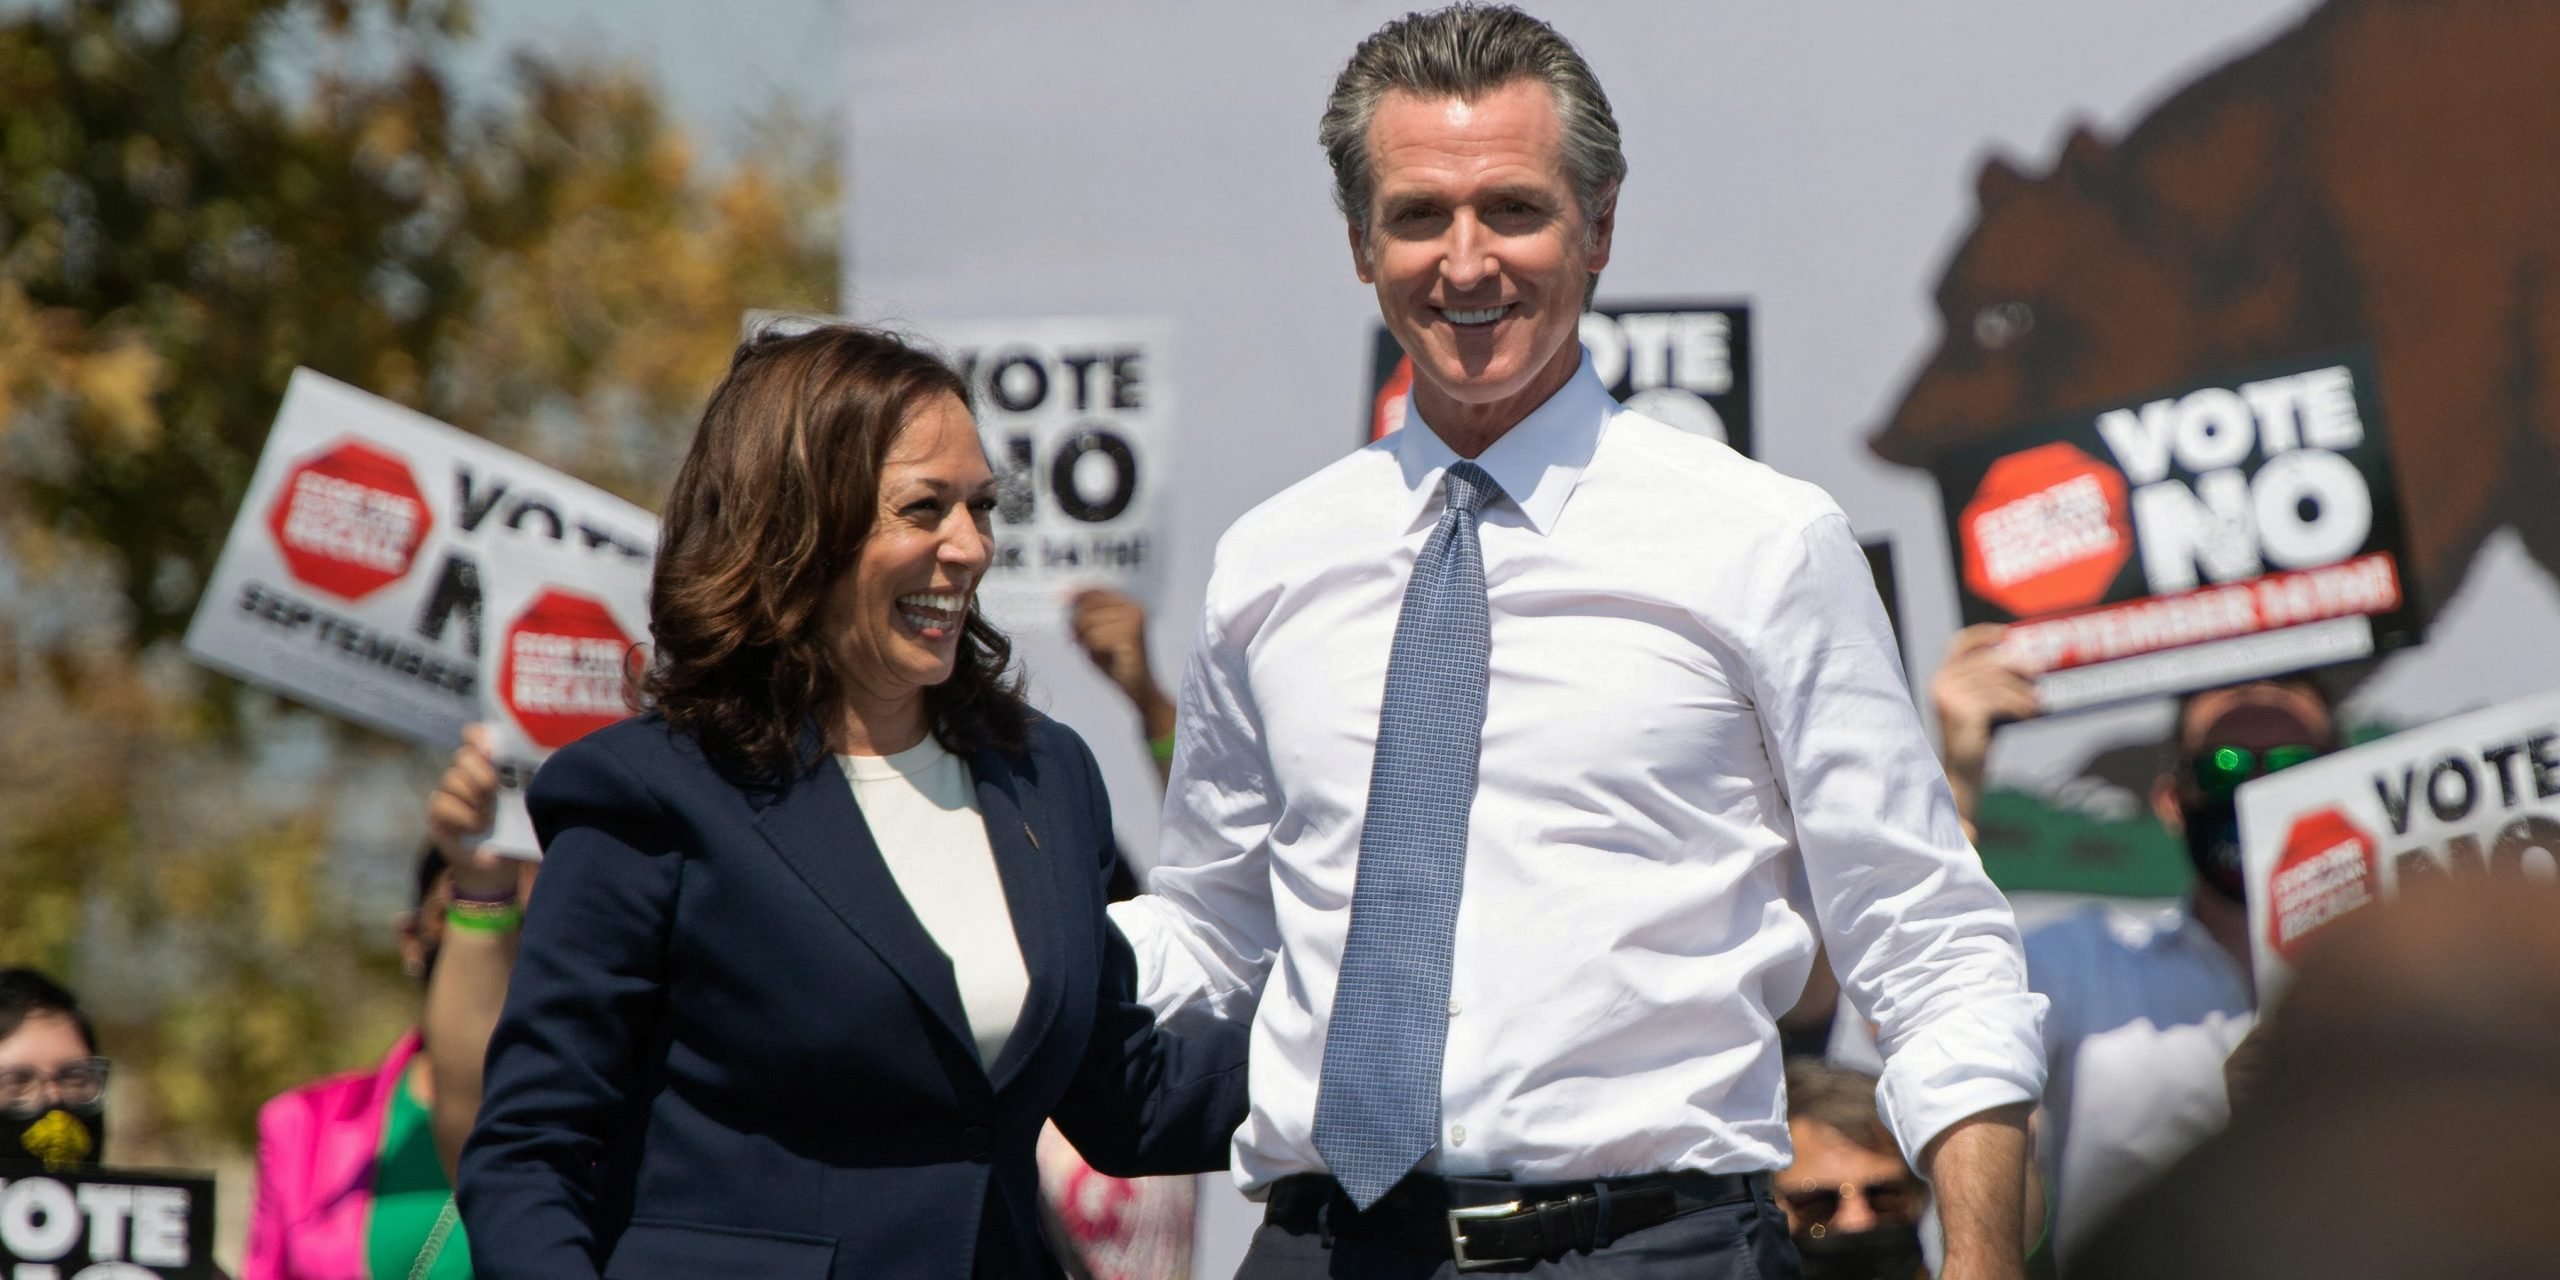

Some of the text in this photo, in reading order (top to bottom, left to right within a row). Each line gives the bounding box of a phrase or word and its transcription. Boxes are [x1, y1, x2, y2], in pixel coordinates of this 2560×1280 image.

[1579, 311, 1733, 394] OTE
[2094, 364, 2365, 486] VOTE
[2131, 448, 2374, 598] NO
[239, 582, 477, 698] SEPTEMBER
[2003, 583, 2255, 673] EPTEMBER
[2374, 730, 2560, 835] VOTE
[0, 1176, 192, 1268] OTE
